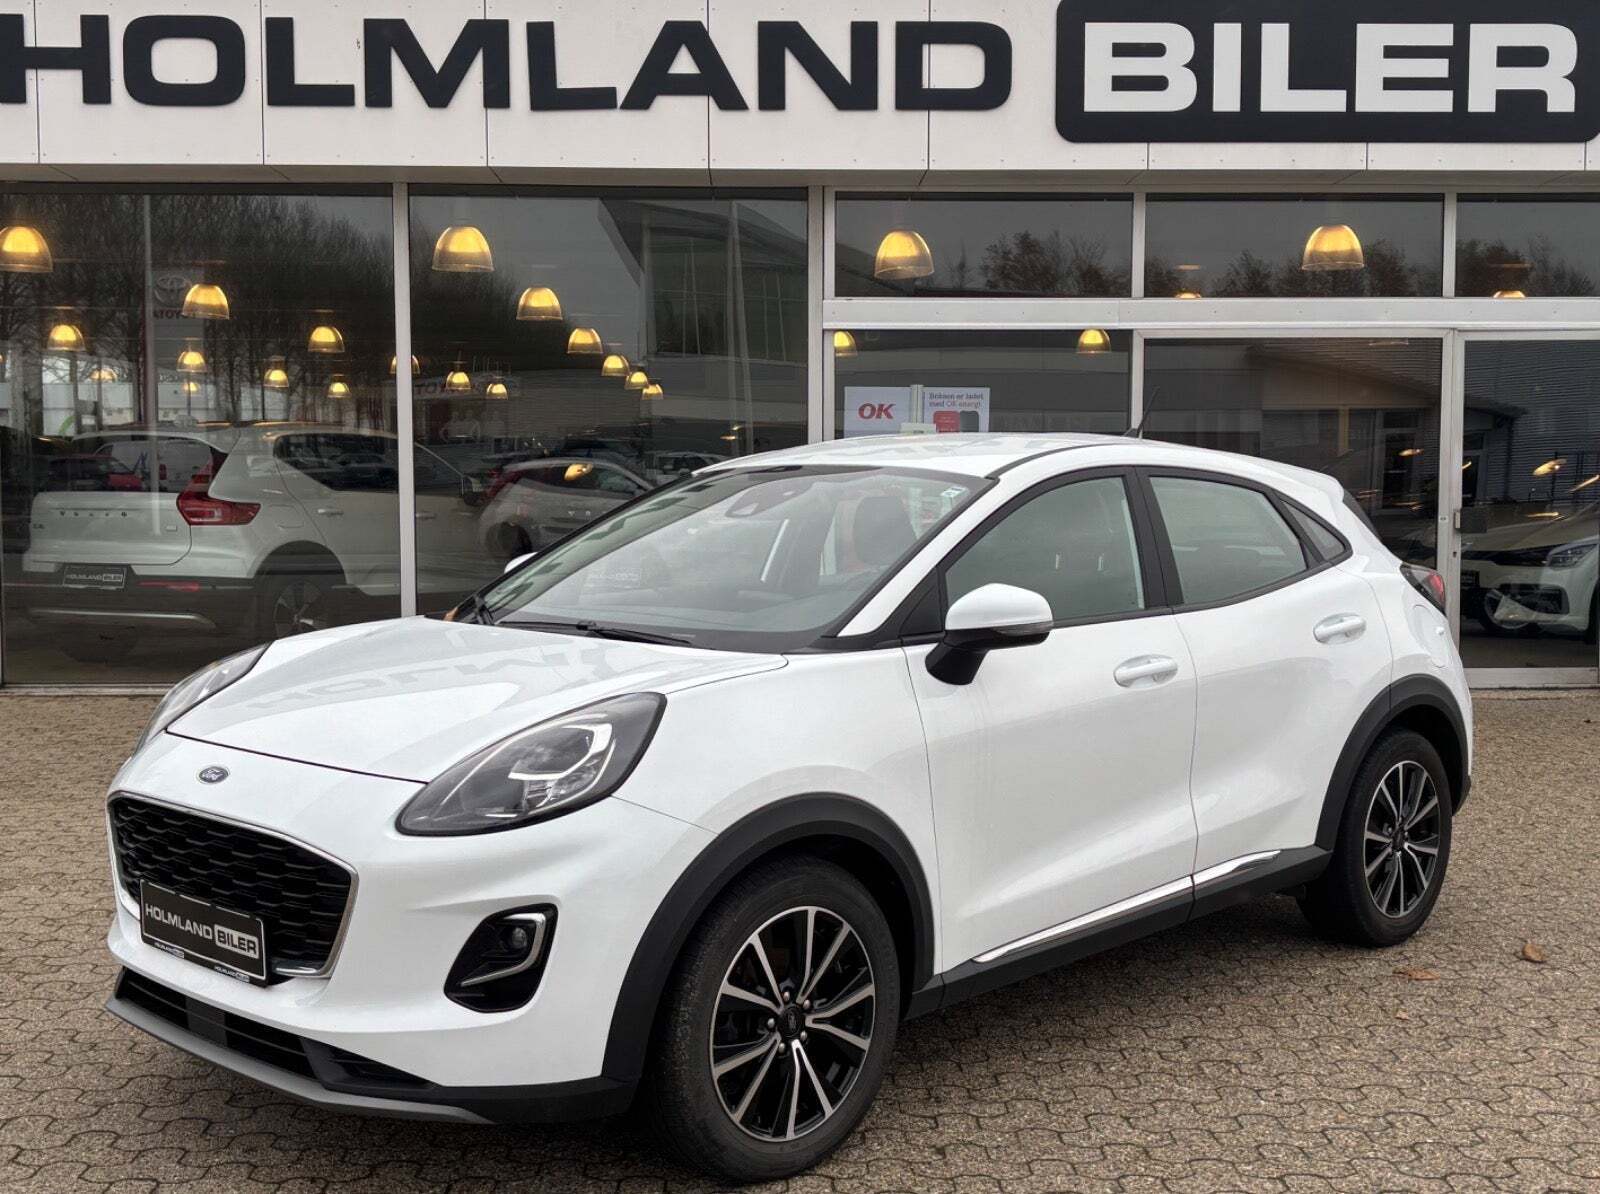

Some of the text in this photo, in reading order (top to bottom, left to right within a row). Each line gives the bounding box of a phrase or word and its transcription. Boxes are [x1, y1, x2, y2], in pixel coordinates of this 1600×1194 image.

[0, 13, 1579, 114] HOLMLAND BILER
[858, 403, 896, 419] OK
[145, 903, 213, 940] HOLMLAND
[217, 928, 257, 955] BILER
